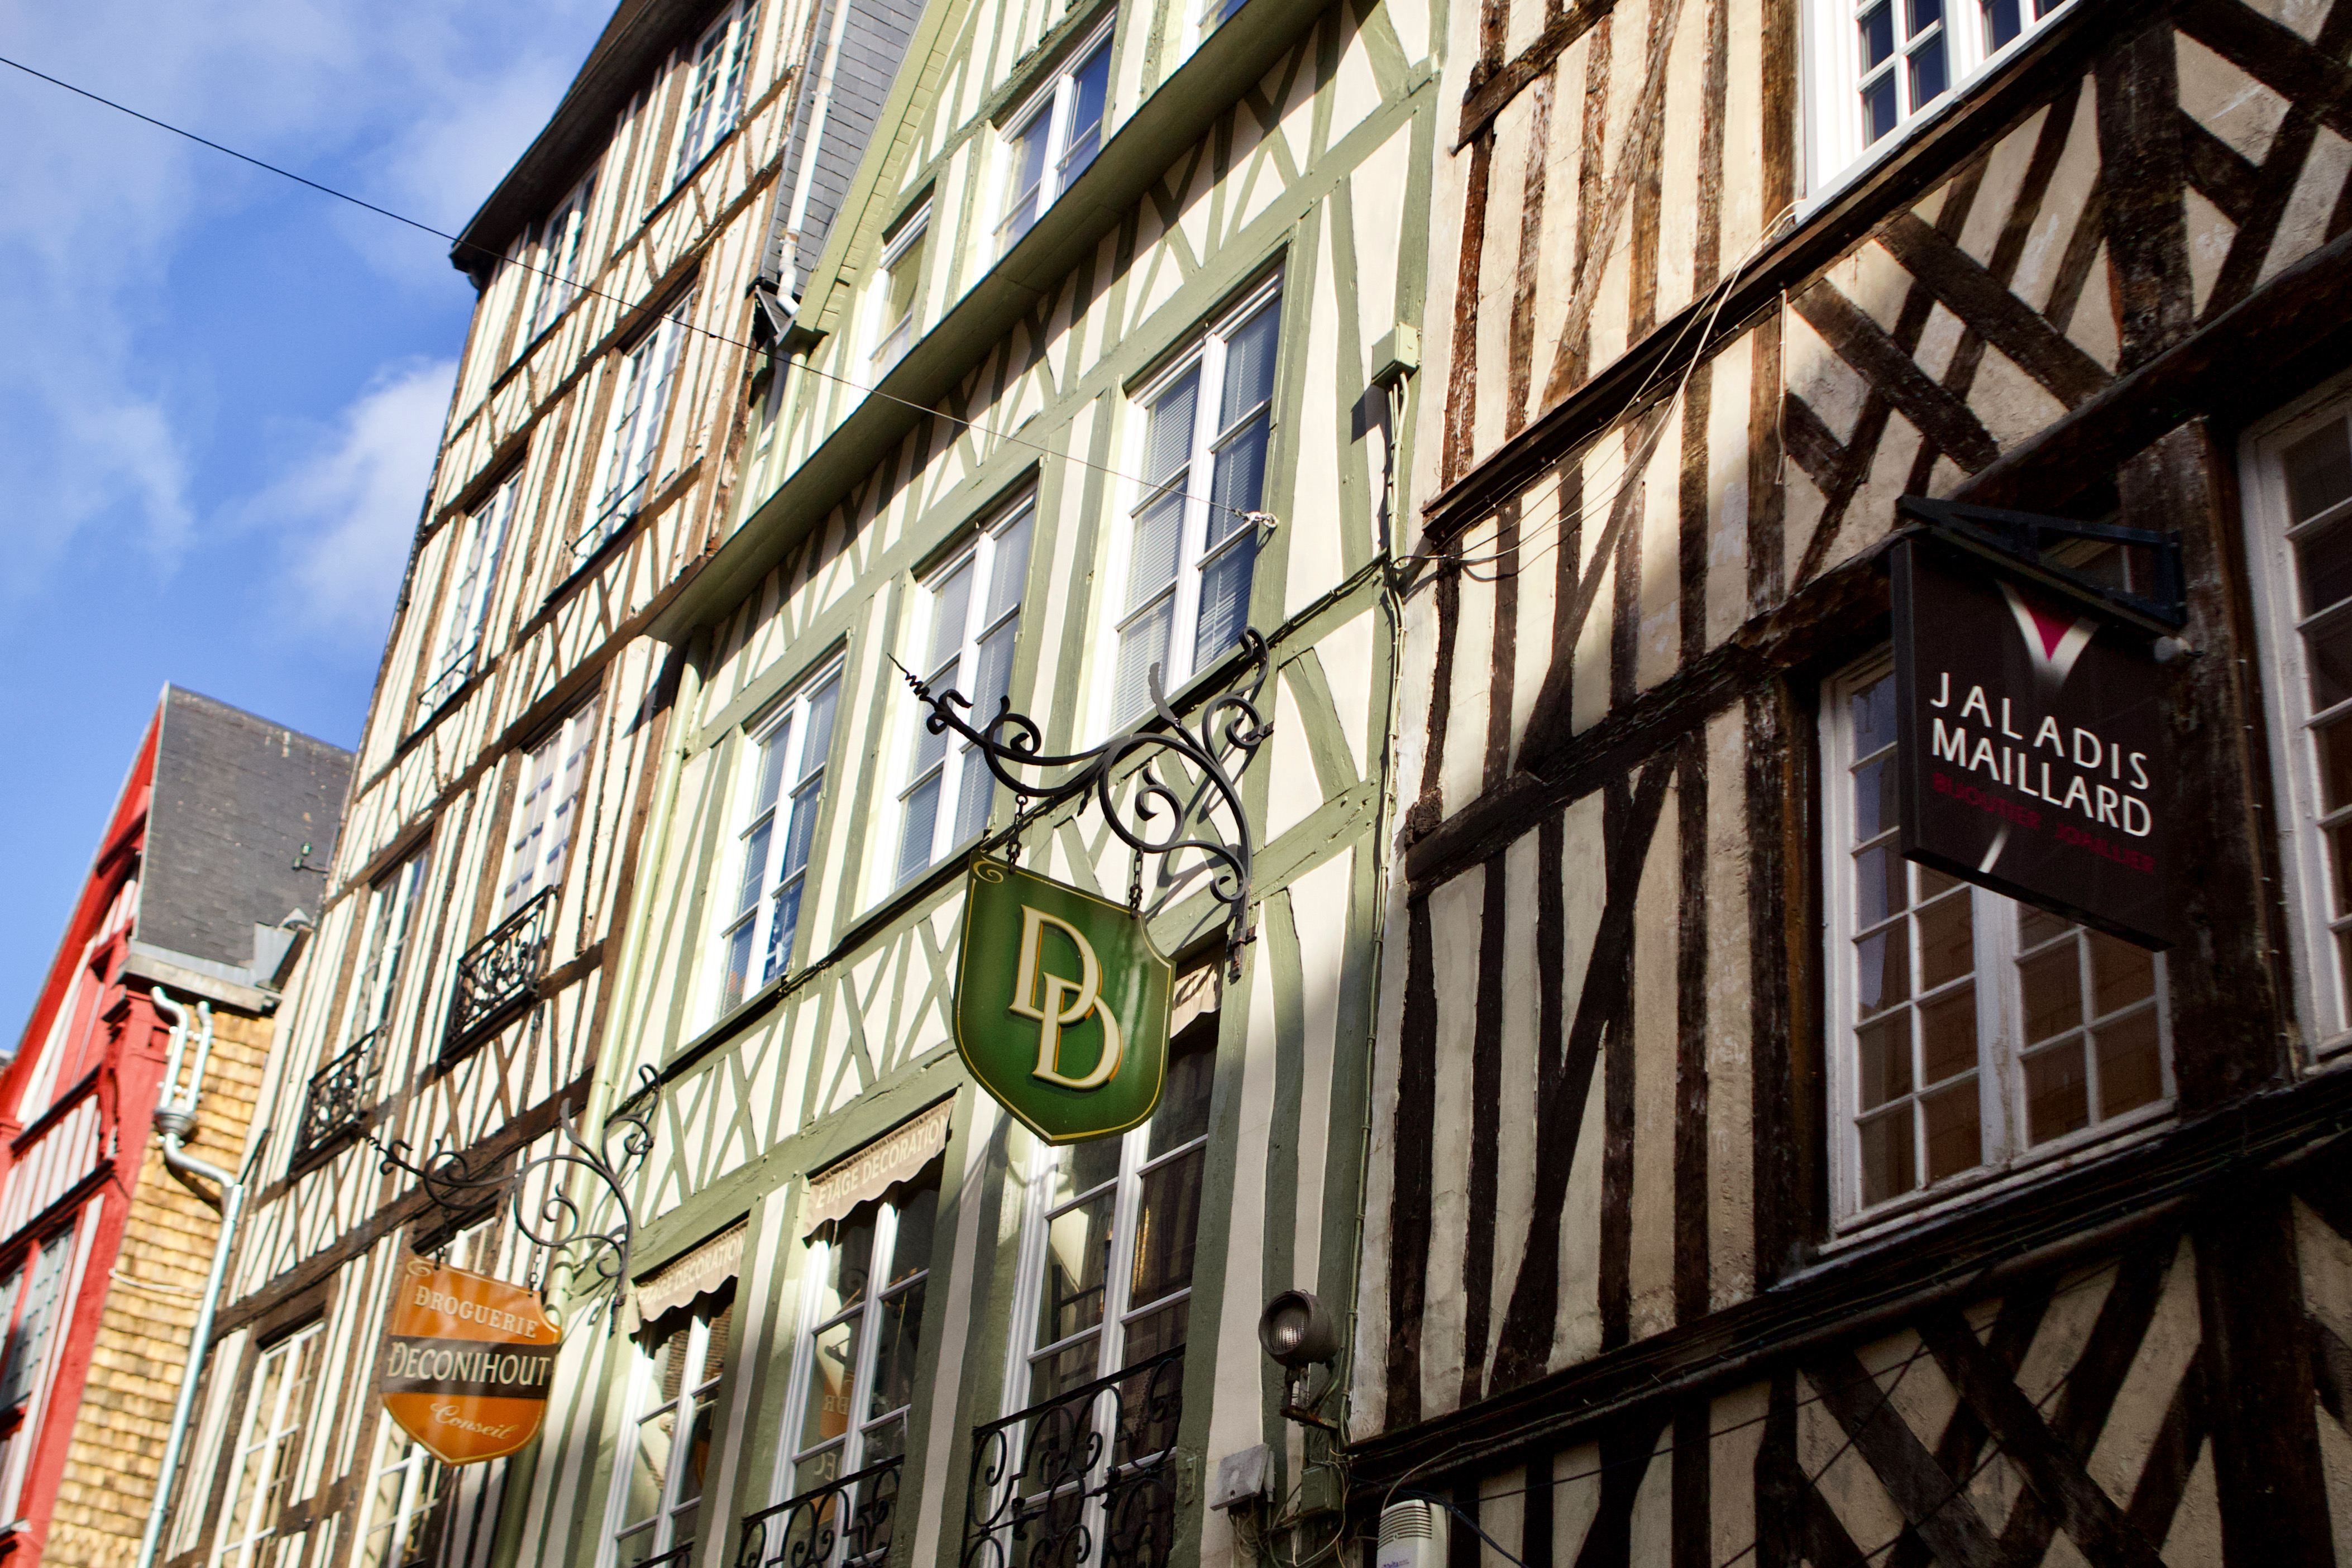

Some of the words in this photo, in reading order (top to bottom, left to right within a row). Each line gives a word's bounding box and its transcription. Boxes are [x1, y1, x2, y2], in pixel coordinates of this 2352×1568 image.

[1930, 672, 2150, 790] JALADIS
[1932, 718, 2153, 837] MAILLARD
[816, 1167, 859, 1208] ETAGE
[414, 1286, 538, 1338] DROGUERIE
[386, 1341, 552, 1387] DECONIHOUT
[430, 1404, 520, 1440] Conseil
